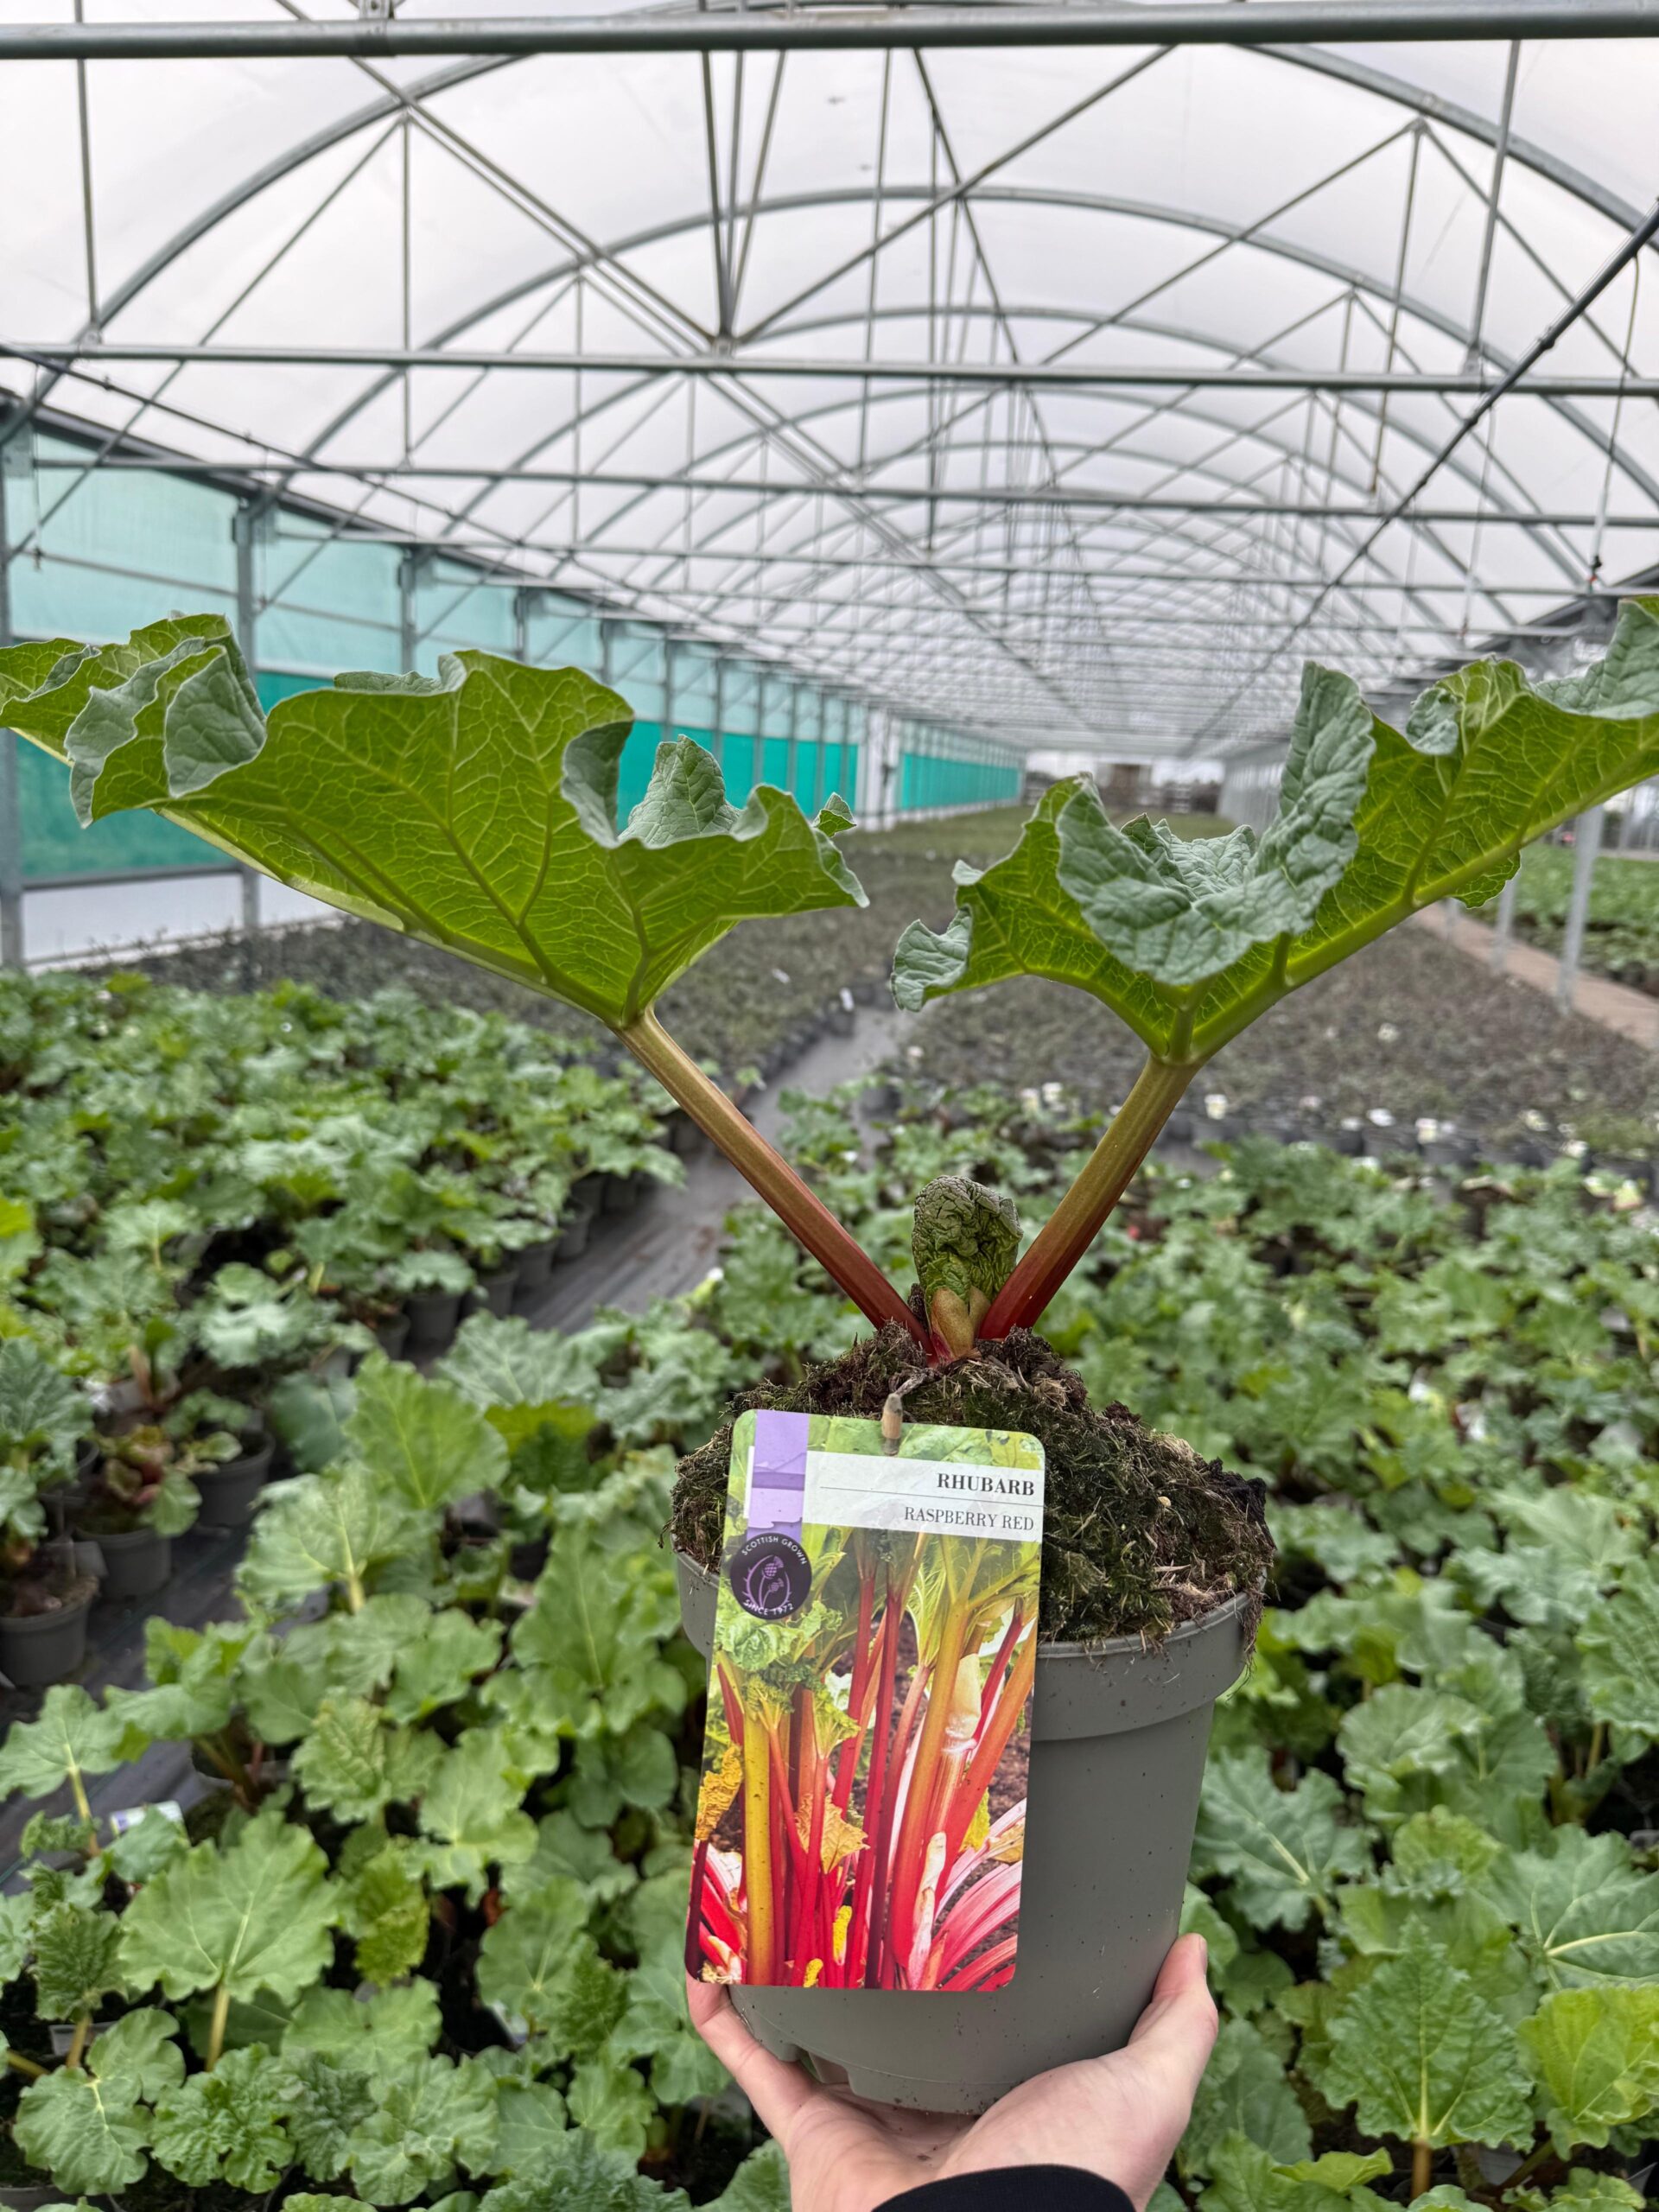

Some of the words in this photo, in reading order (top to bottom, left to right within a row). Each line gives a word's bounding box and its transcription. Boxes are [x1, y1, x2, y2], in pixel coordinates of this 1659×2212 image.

[937, 1472, 1035, 1496] RHUBARB
[905, 1506, 998, 1528] RASPBERRY
[1002, 1515, 1034, 1531] RED
[741, 1536, 779, 1555] SCOTTISH
[781, 1538, 807, 1565] GROWN
[742, 1599, 768, 1616] SINCE
[773, 1603, 794, 1615] 1972
